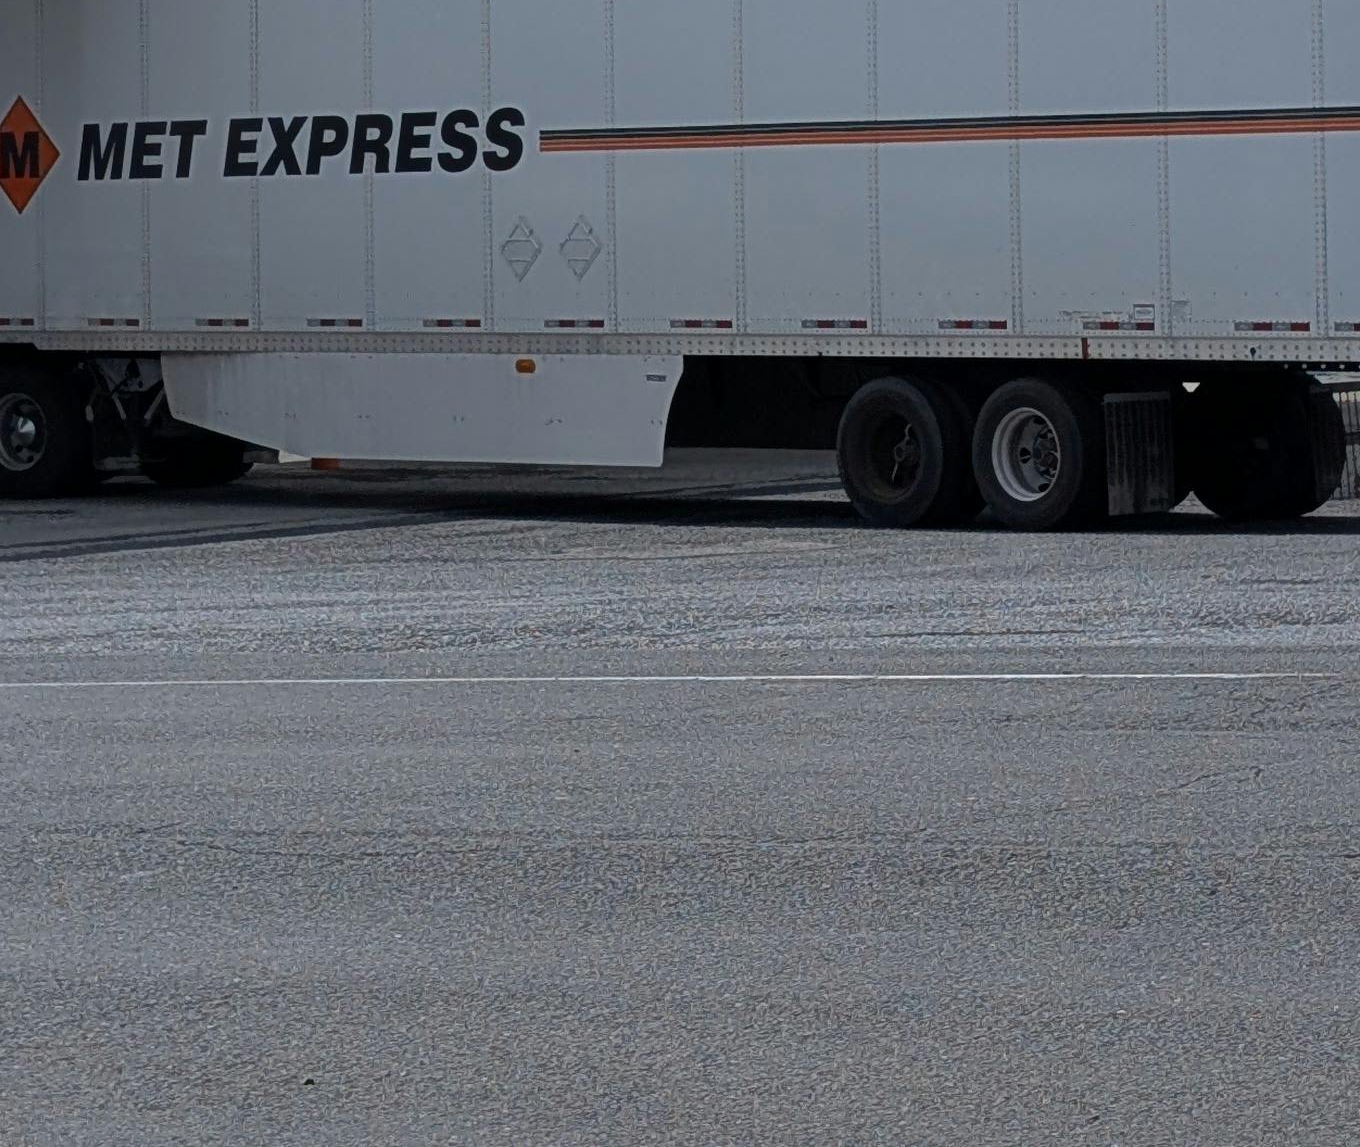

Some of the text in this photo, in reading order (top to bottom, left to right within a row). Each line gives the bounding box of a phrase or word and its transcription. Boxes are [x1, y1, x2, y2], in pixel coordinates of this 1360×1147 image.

[0, 131, 40, 179] M
[77, 107, 526, 181] MET EXPRESS
